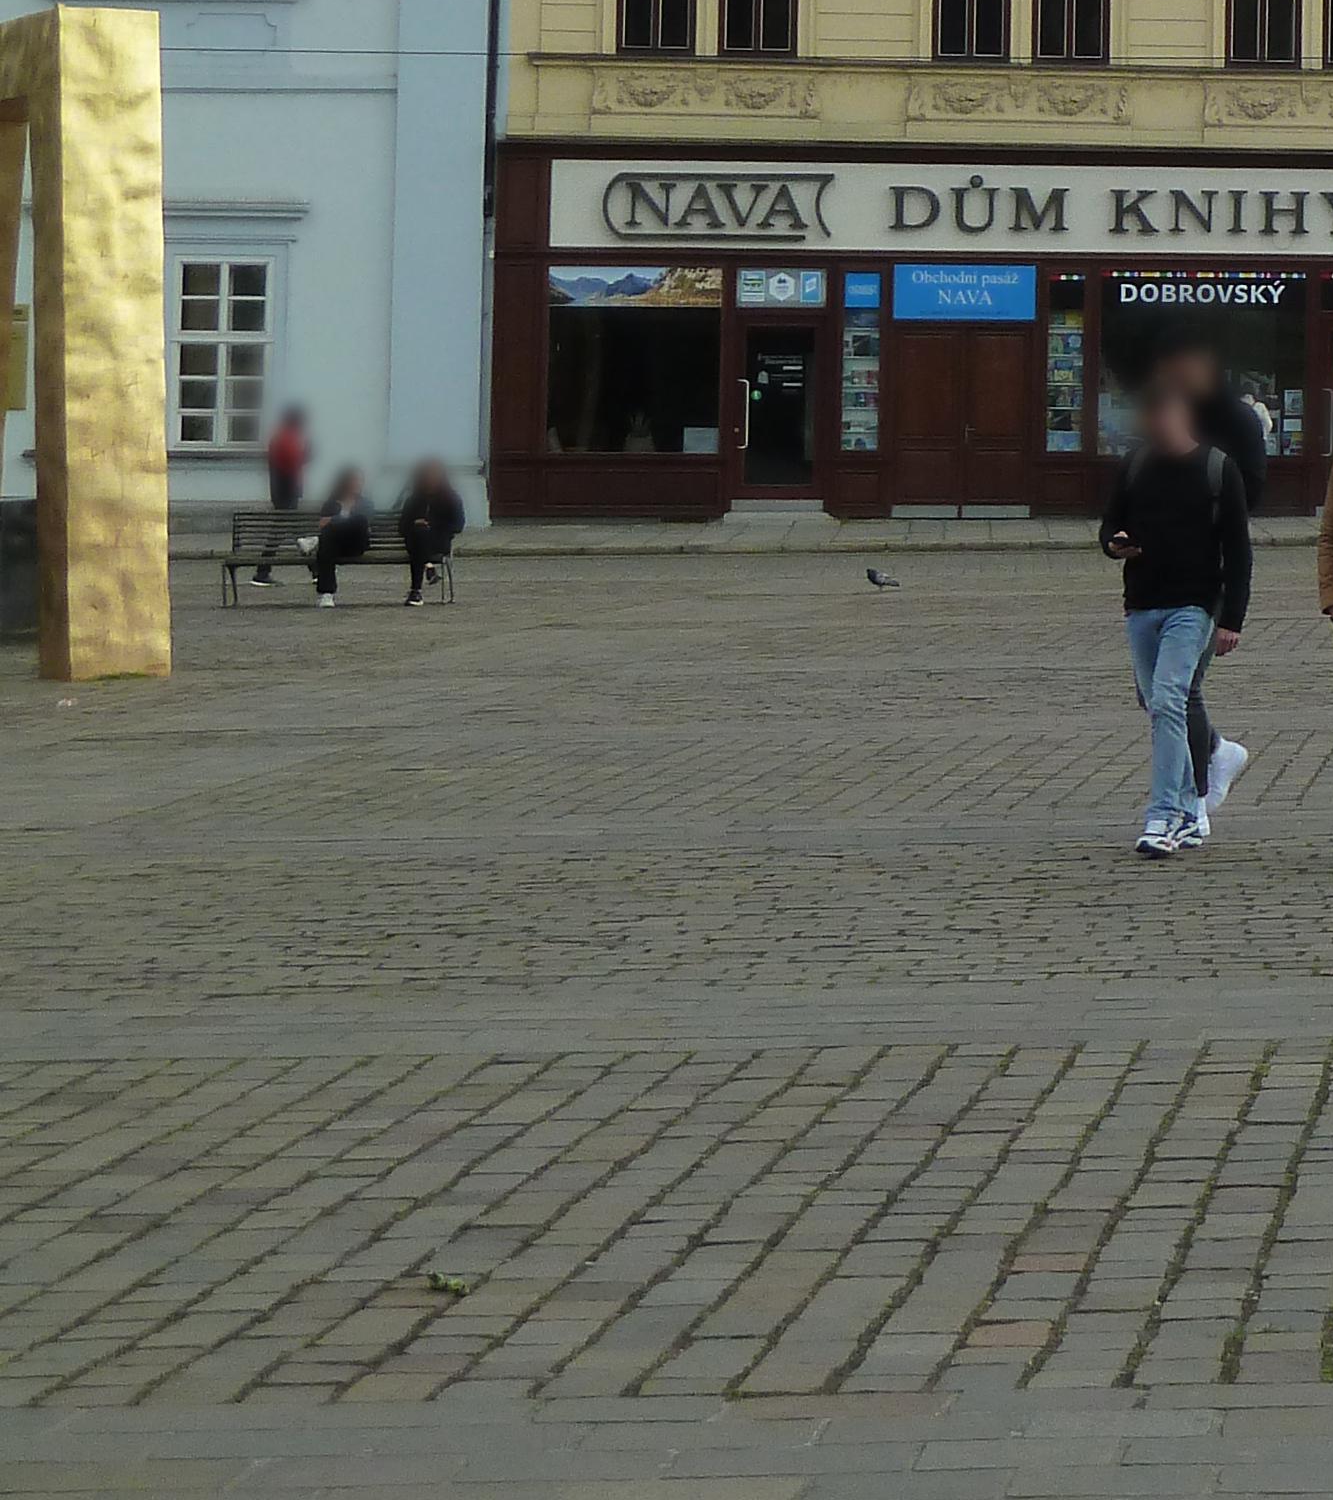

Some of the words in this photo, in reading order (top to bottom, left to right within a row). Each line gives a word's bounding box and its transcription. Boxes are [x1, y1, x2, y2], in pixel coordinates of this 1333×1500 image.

[624, 181, 808, 231] NAVA
[888, 174, 1071, 234] DŮM
[911, 270, 977, 284] Obchodní
[981, 271, 1019, 288] pasáž
[938, 289, 993, 305] NAVA
[1119, 280, 1287, 305] DOBROVSKÝ
